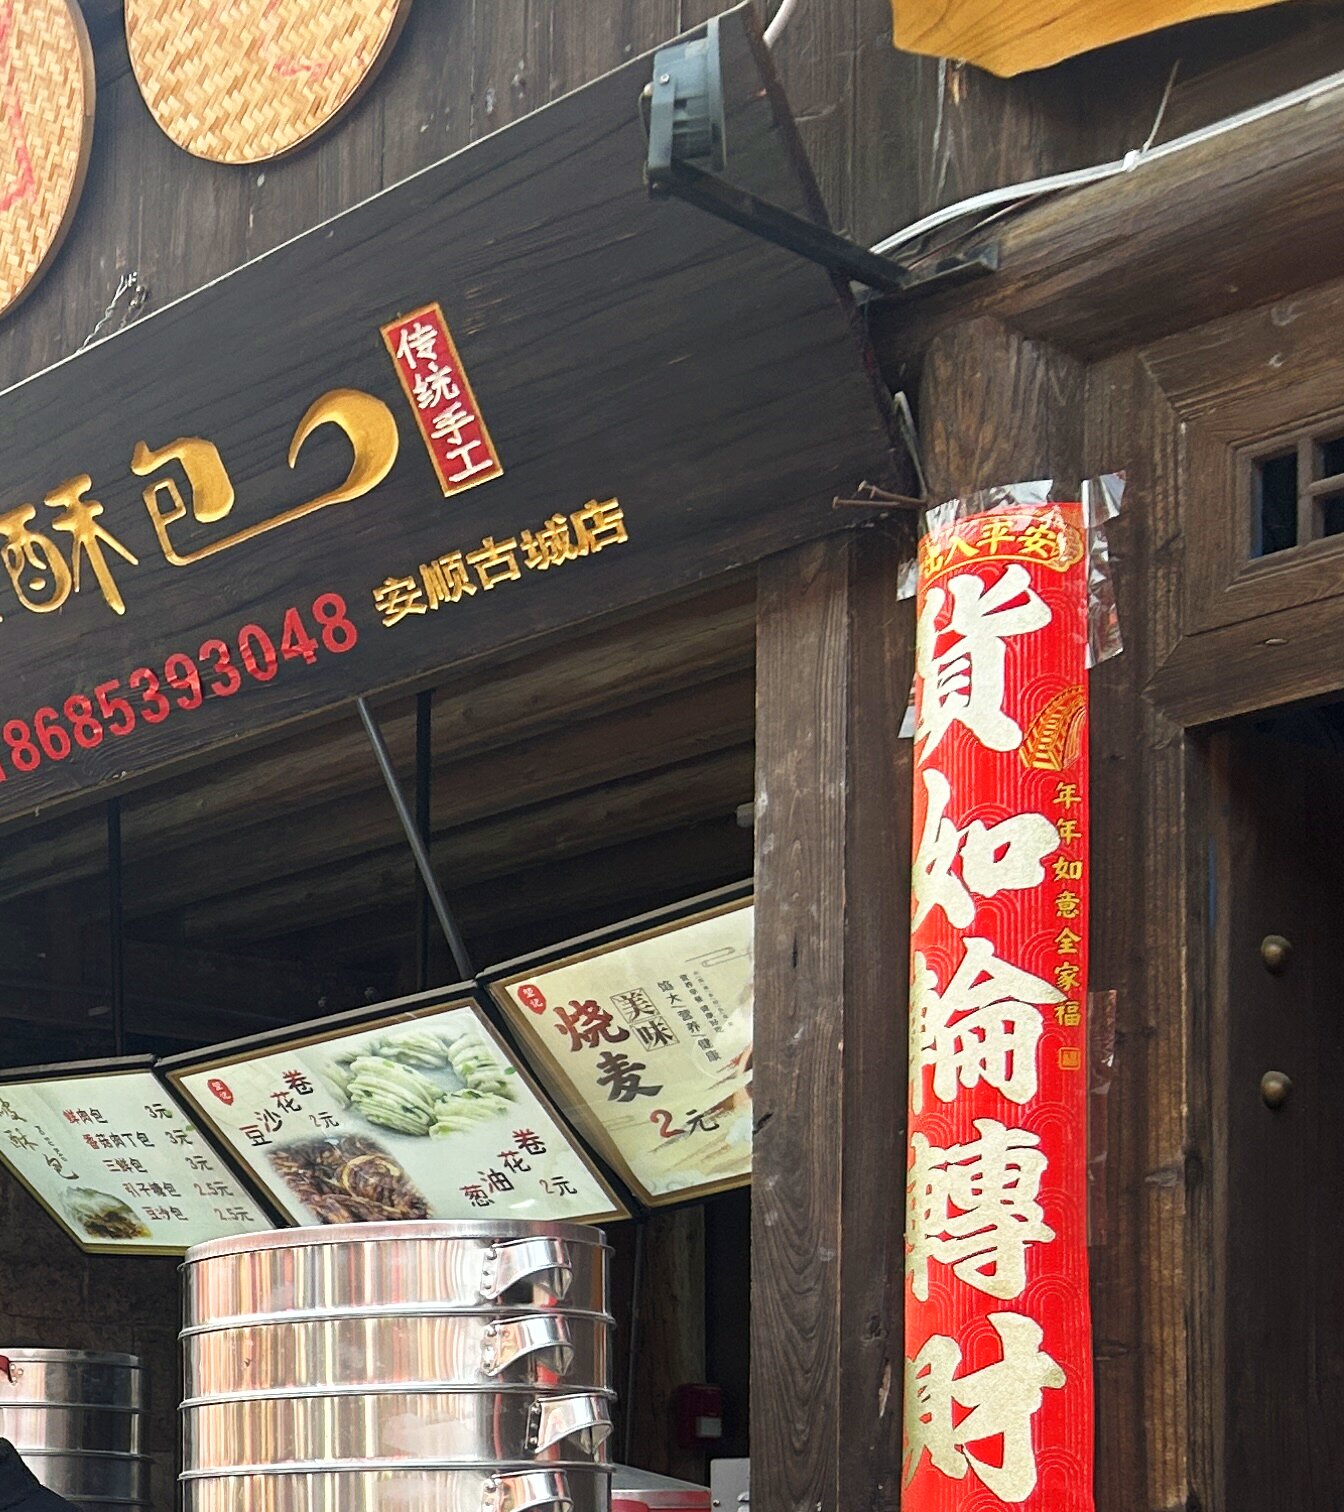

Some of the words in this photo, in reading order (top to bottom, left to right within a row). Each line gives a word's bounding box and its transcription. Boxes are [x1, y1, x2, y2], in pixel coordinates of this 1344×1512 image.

[397, 322, 493, 483] 传统手工
[372, 497, 629, 627] 安顺古城店
[924, 520, 1057, 577] 出入平安
[1052, 782, 1082, 1028] 年年如意全家福
[553, 1000, 664, 1103] 烧麦
[621, 992, 674, 1047] 美味
[239, 1070, 314, 1147] 豆沙花卷
[309, 1111, 340, 1130] 2元
[650, 1109, 720, 1138] 2元
[460, 1128, 547, 1208] 葱油花卷
[539, 1176, 578, 1197] 2元
